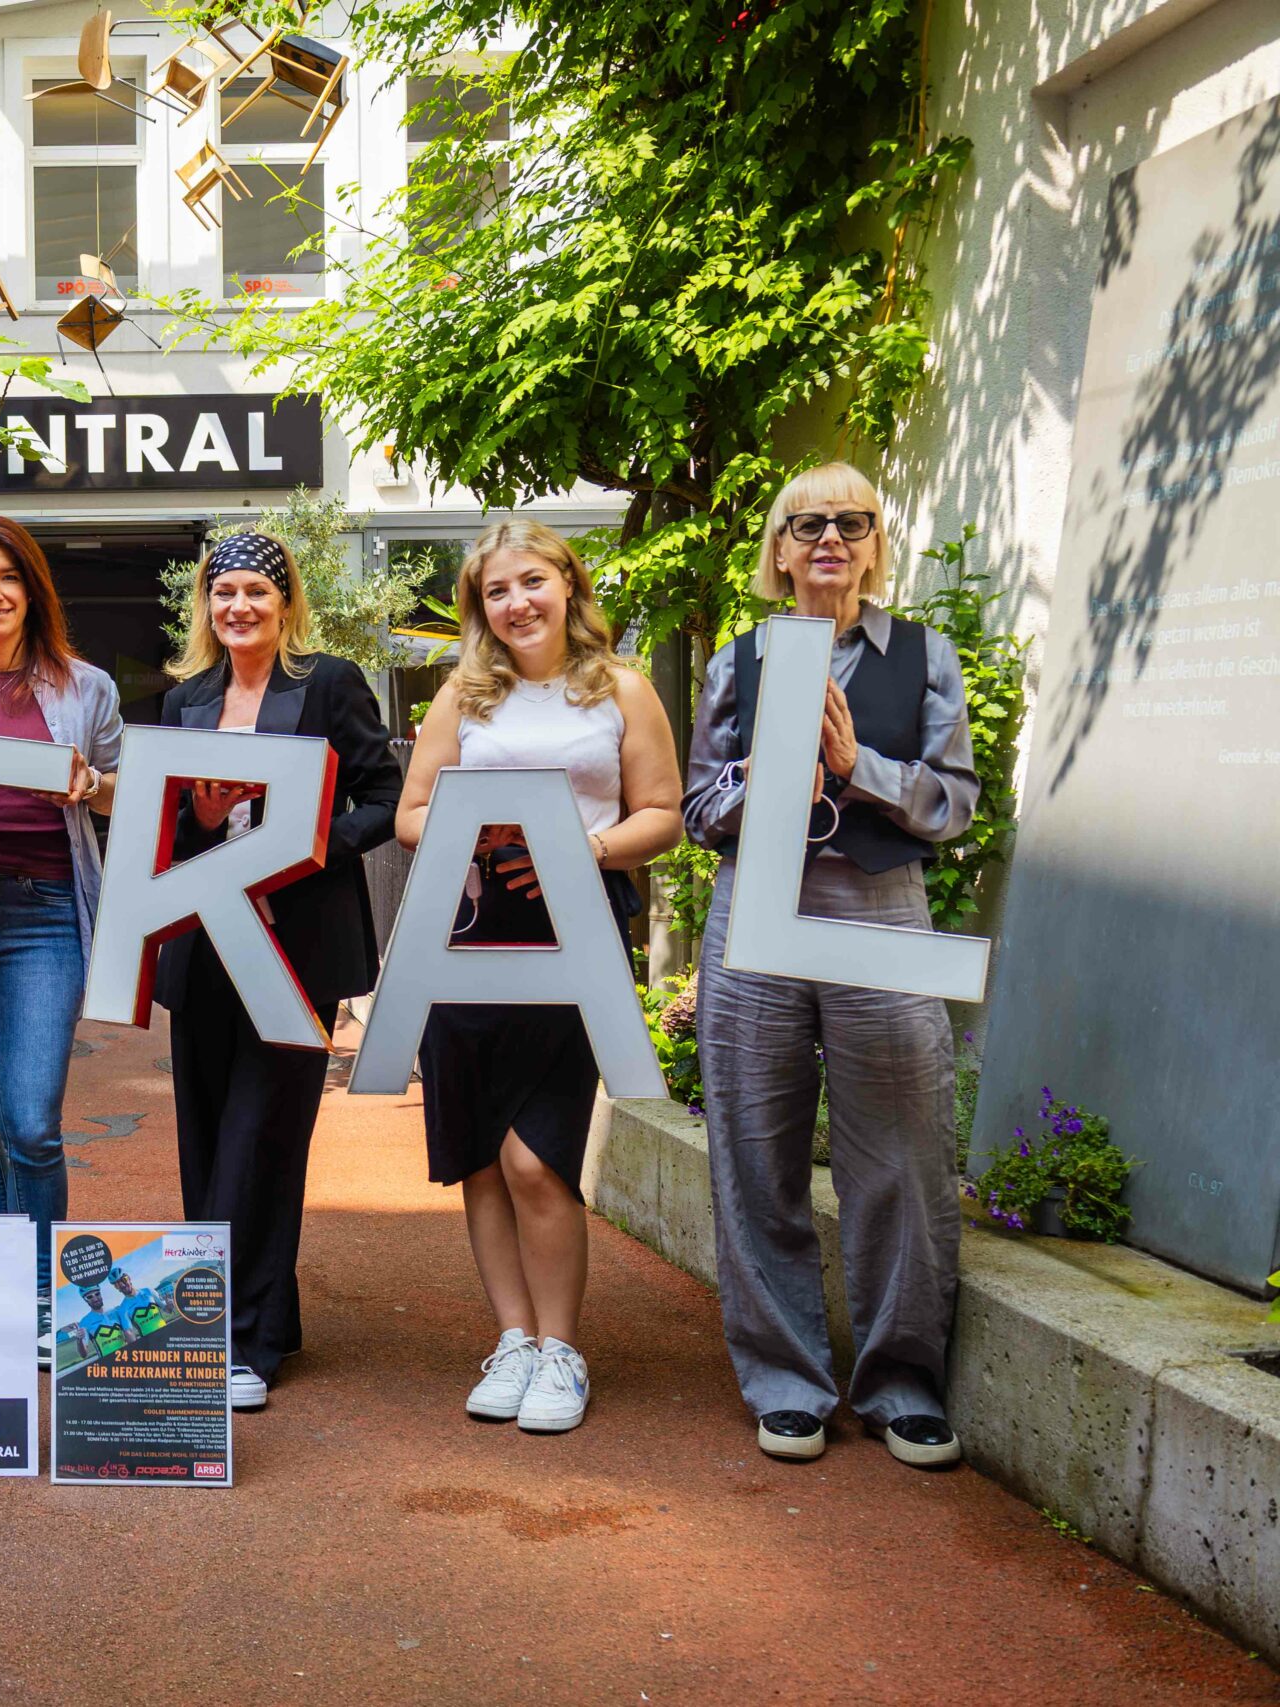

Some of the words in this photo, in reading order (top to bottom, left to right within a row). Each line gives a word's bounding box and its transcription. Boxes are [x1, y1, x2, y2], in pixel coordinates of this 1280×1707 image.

[57, 279, 86, 294] SPÖ
[244, 276, 273, 294] SPÖ
[1194, 583, 1227, 606] allem
[1230, 578, 1260, 602] alles
[1157, 627, 1191, 651] getan
[1193, 618, 1240, 643] worden
[1243, 614, 1261, 637] ist
[1214, 654, 1234, 677] die
[1122, 697, 1149, 717] nicht
[1152, 694, 1229, 717] wiederholen.
[1218, 747, 1261, 765] Gertrude
[115, 1350, 128, 1362] 24
[132, 1350, 180, 1363] STUNDEN
[184, 1351, 226, 1363] RADELN
[87, 1364, 108, 1378] FÜR
[111, 1366, 182, 1379] HERZKRANKE
[185, 1367, 226, 1380] KINDER
[196, 1463, 223, 1475] ARBÖ
